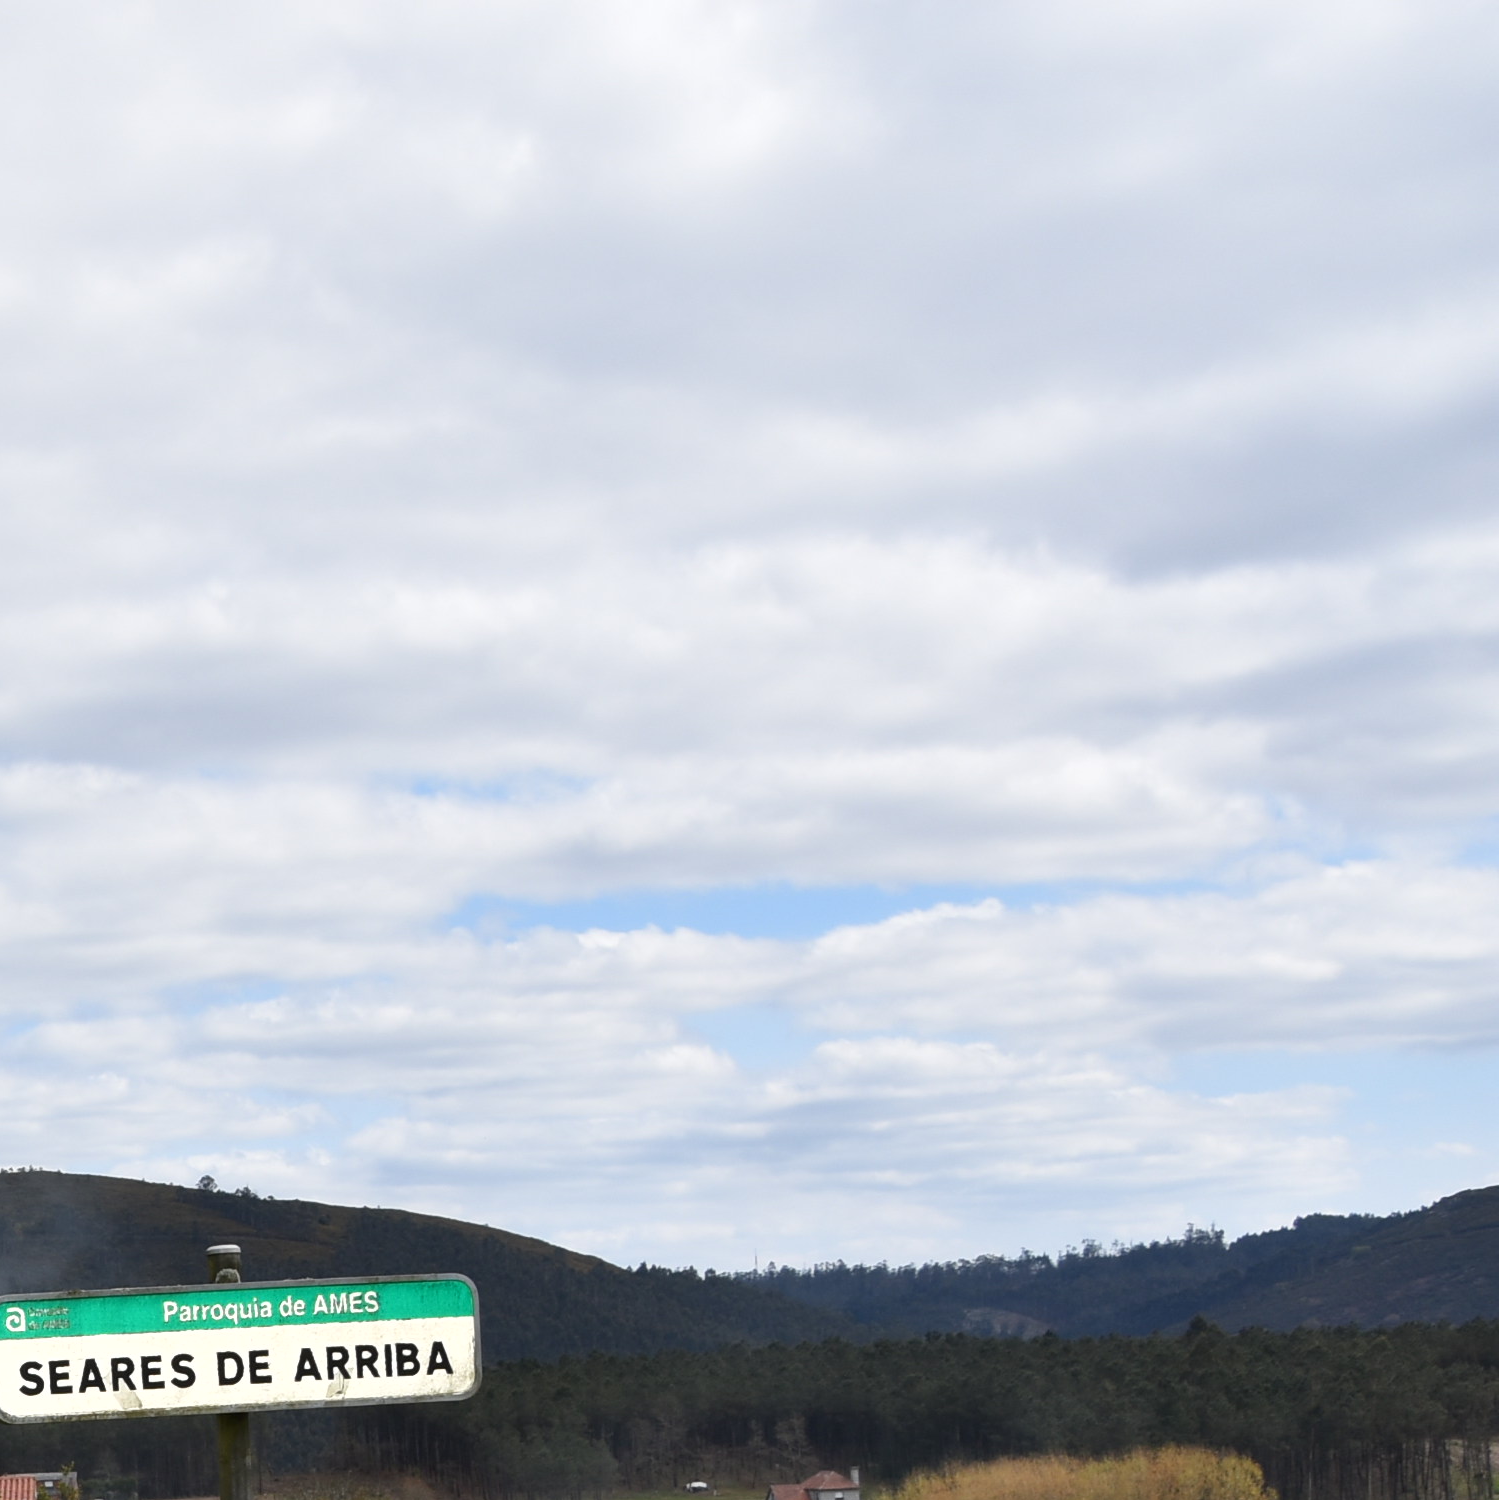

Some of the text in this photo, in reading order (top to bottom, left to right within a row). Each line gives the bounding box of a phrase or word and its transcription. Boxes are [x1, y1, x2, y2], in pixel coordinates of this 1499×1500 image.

[163, 1291, 380, 1325] Parroquia de AMES
[19, 1341, 454, 1397] SEARES DE ARRIBA
